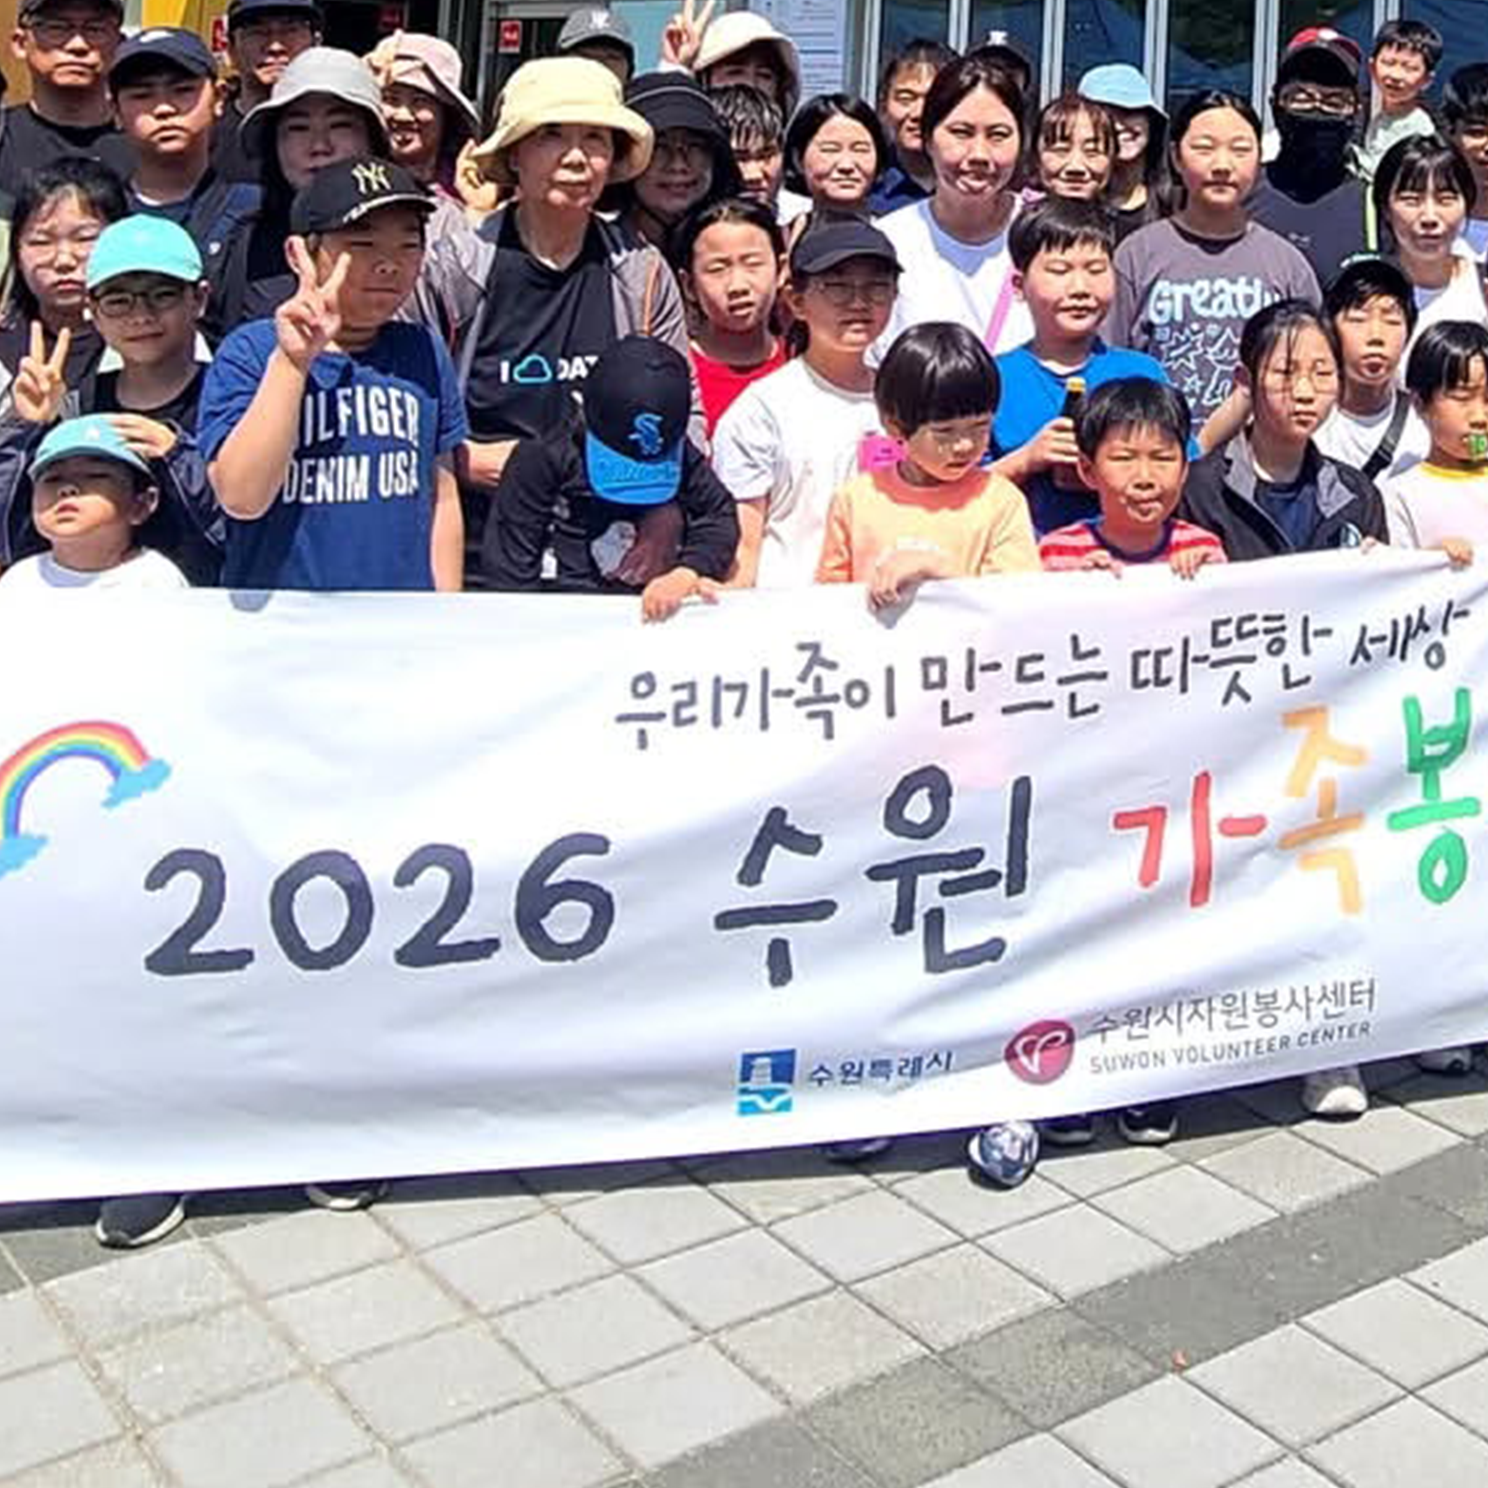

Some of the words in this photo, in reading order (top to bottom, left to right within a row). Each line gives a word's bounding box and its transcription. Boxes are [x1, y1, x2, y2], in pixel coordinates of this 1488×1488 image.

[305, 385, 419, 447] ILFIGER
[283, 455, 369, 504] DENIM
[617, 640, 896, 749] 우리가족이
[921, 633, 1109, 729] 만드는
[1131, 611, 1334, 706] 따뜻한
[1350, 599, 1470, 673] 세상
[144, 832, 615, 976] 2026
[714, 764, 1032, 988] 수원
[1092, 977, 1377, 1044] 수원시자원봉사센터
[811, 1050, 954, 1087] 수원특례시
[1090, 1050, 1167, 1075] SUWON
[1175, 1036, 1290, 1065] VOLUNTEER
[1297, 1022, 1370, 1048] CENTER
